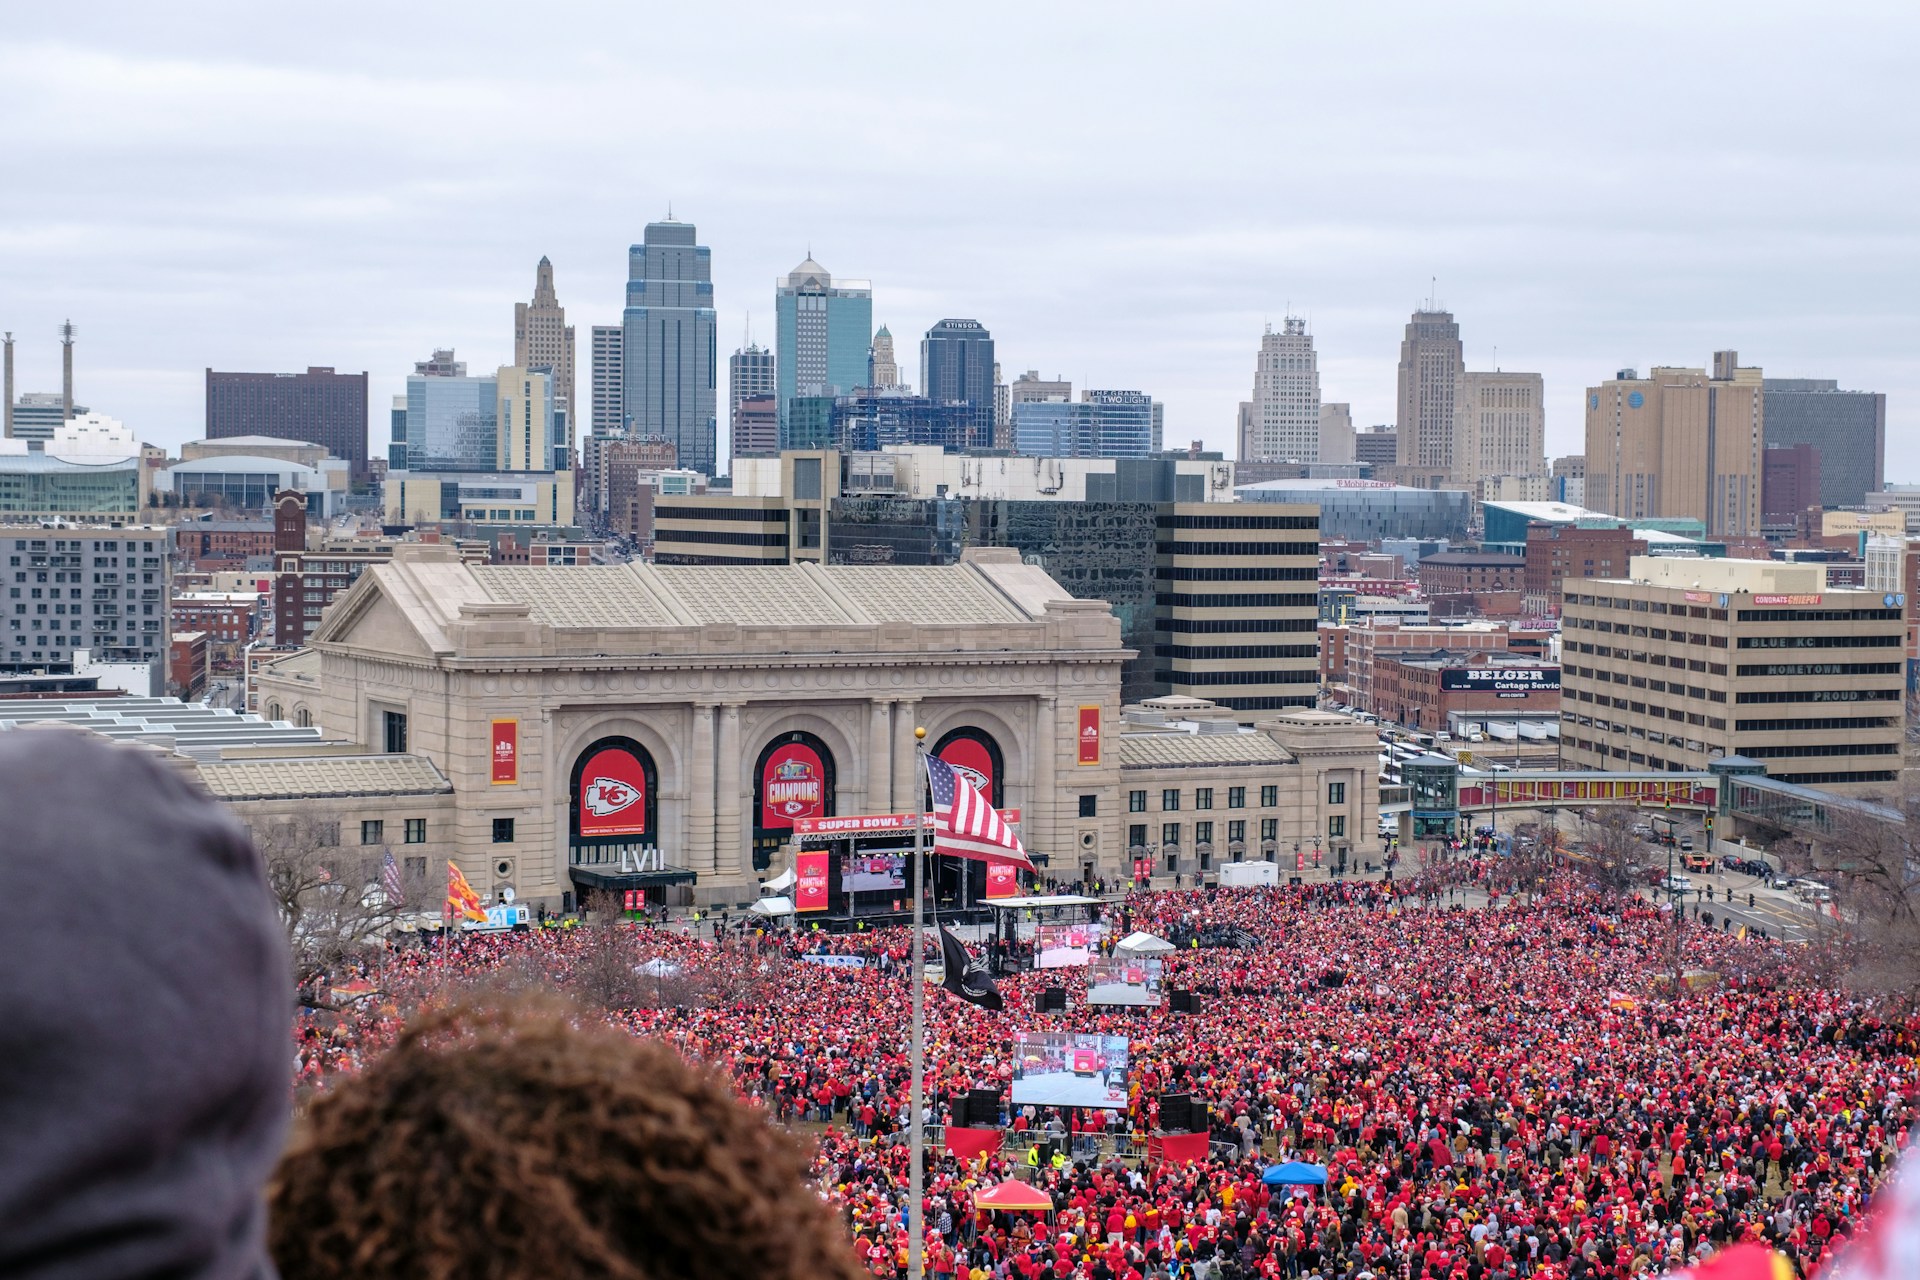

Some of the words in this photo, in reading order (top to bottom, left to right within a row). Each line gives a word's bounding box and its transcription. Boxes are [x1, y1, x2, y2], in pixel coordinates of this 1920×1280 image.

[618, 433, 666, 441] PRESIDENT
[1788, 596, 1818, 604] CHIEFS!
[1752, 638, 1786, 647] BLUE
[1797, 638, 1814, 647] KC
[1768, 665, 1841, 674] HOMETOWN
[1467, 671, 1543, 680] BELGER
[1495, 682, 1529, 690] Cartage
[1814, 692, 1857, 701] PROUD
[770, 782, 818, 803] CHAMPIONS
[1499, 782, 1559, 798] WORLD
[1578, 782, 1689, 798] CHAMPIONS
[599, 786, 627, 806] KC
[818, 819, 859, 830] SUPER
[863, 817, 899, 828] BOWL
[622, 849, 664, 872] LVII
[989, 865, 1014, 876] CHAMPIONS
[799, 876, 826, 887] CHAMPIONS
[873, 1249, 880, 1258] 32
[1544, 1269, 1553, 1279] 15
